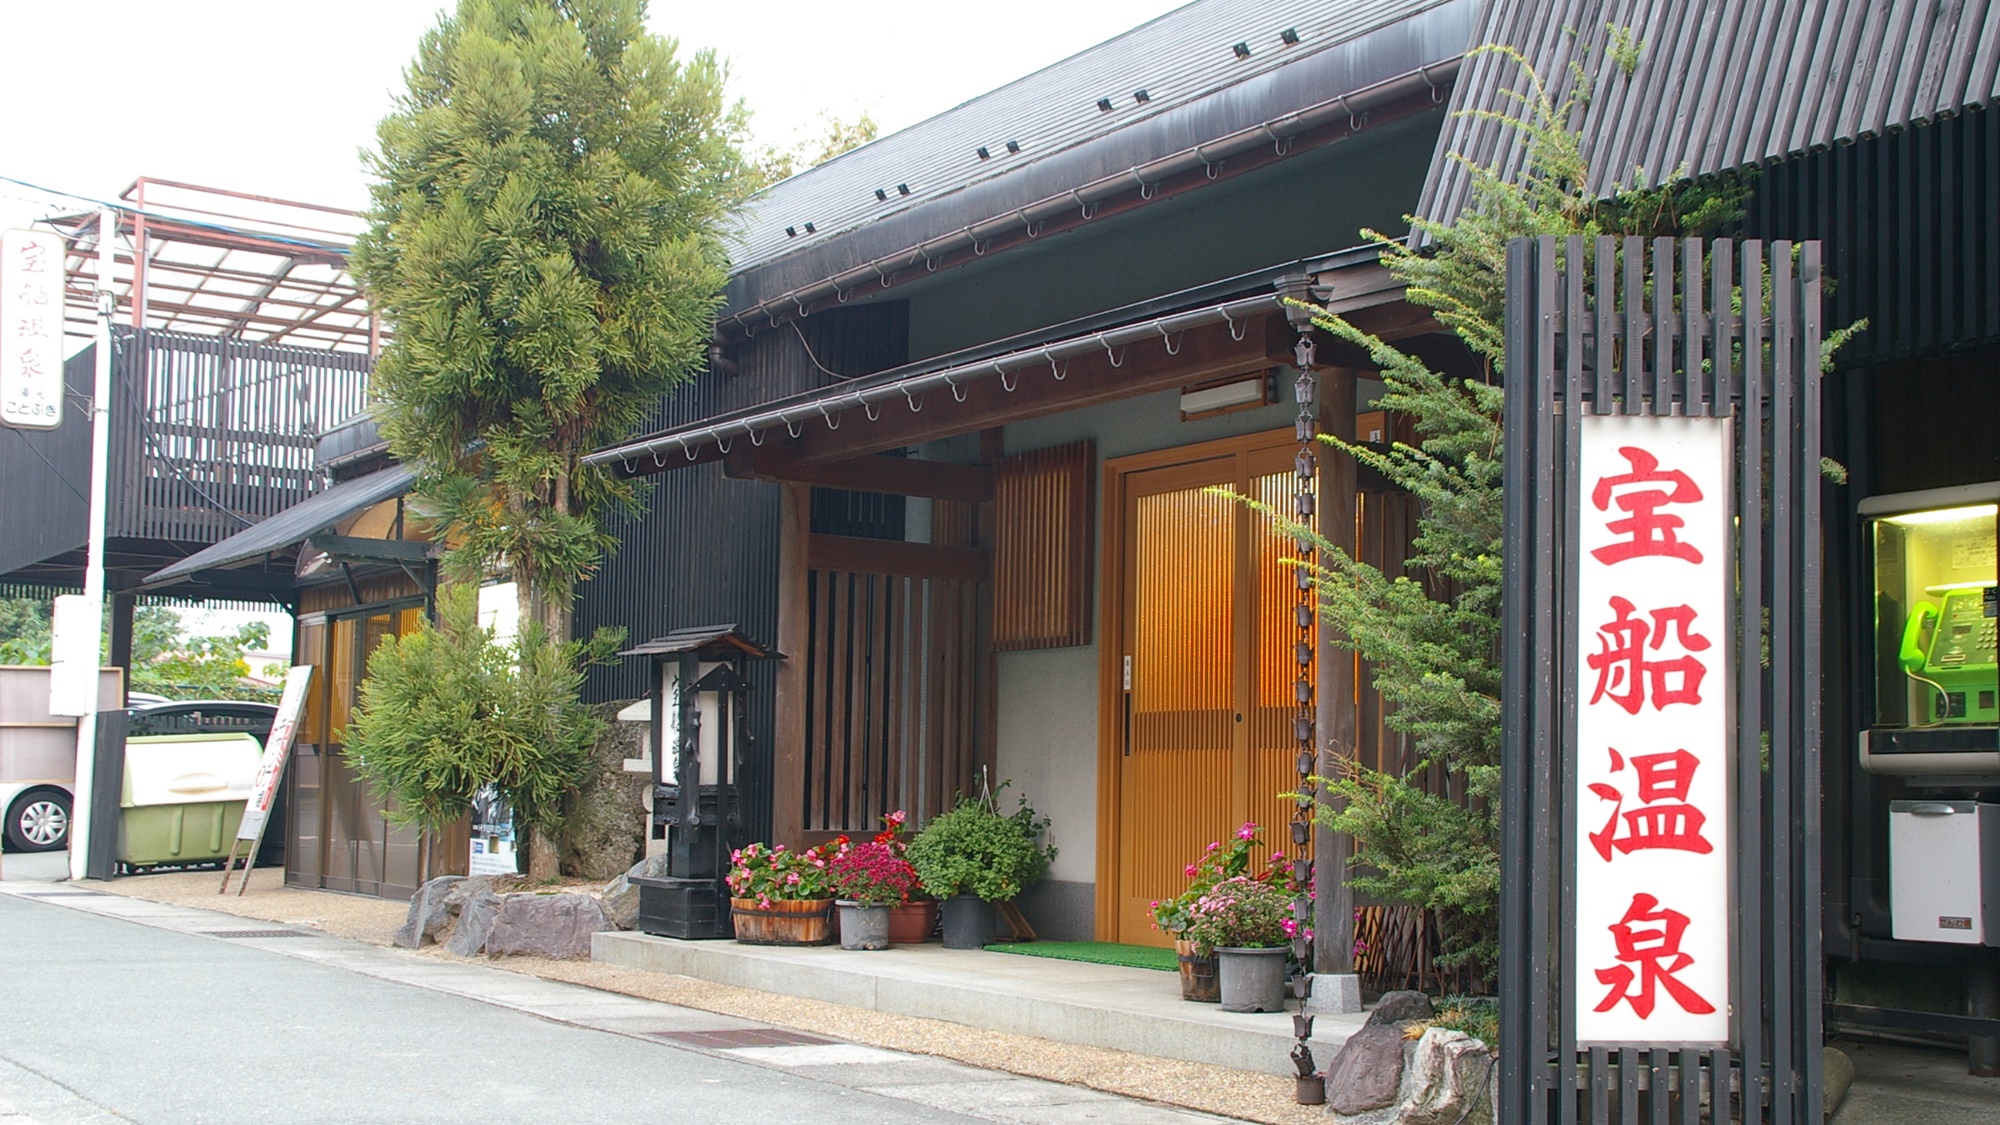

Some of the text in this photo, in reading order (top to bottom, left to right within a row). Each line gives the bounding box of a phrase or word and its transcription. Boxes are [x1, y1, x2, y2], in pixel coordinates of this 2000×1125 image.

[5, 401, 56, 417] ことぶき
[1586, 446, 1716, 1020] 宝船温泉
